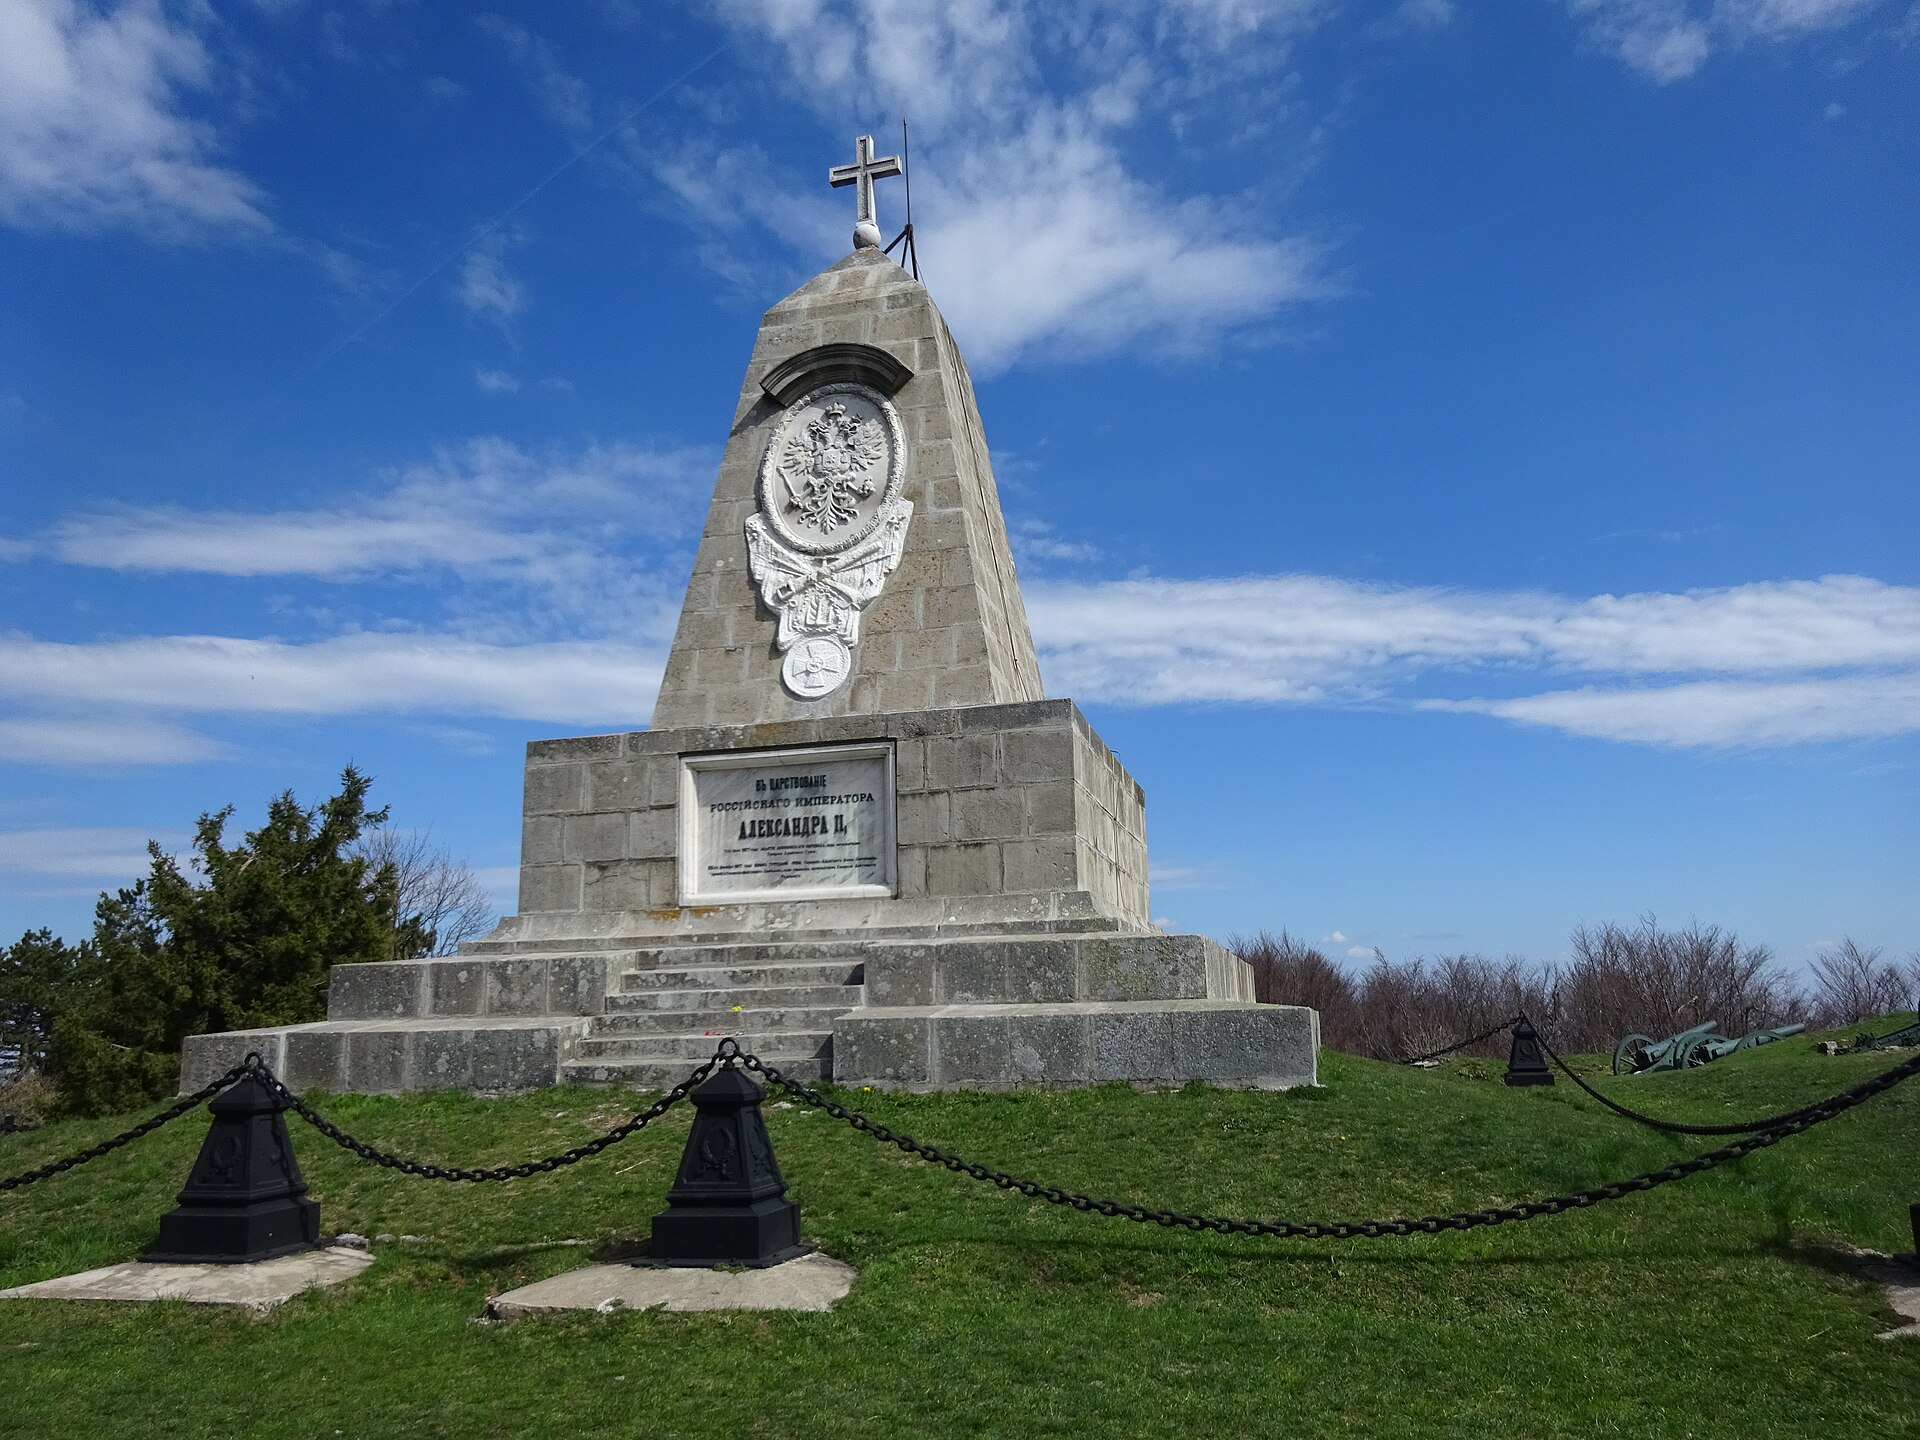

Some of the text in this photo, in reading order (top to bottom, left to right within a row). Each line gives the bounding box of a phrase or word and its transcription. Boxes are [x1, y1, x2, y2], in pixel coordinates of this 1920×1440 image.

[755, 779, 767, 792] ВЪ
[795, 793, 874, 808] ИМПЕРАТОРА
[738, 815, 829, 840] АЛЕКСАНДРА
